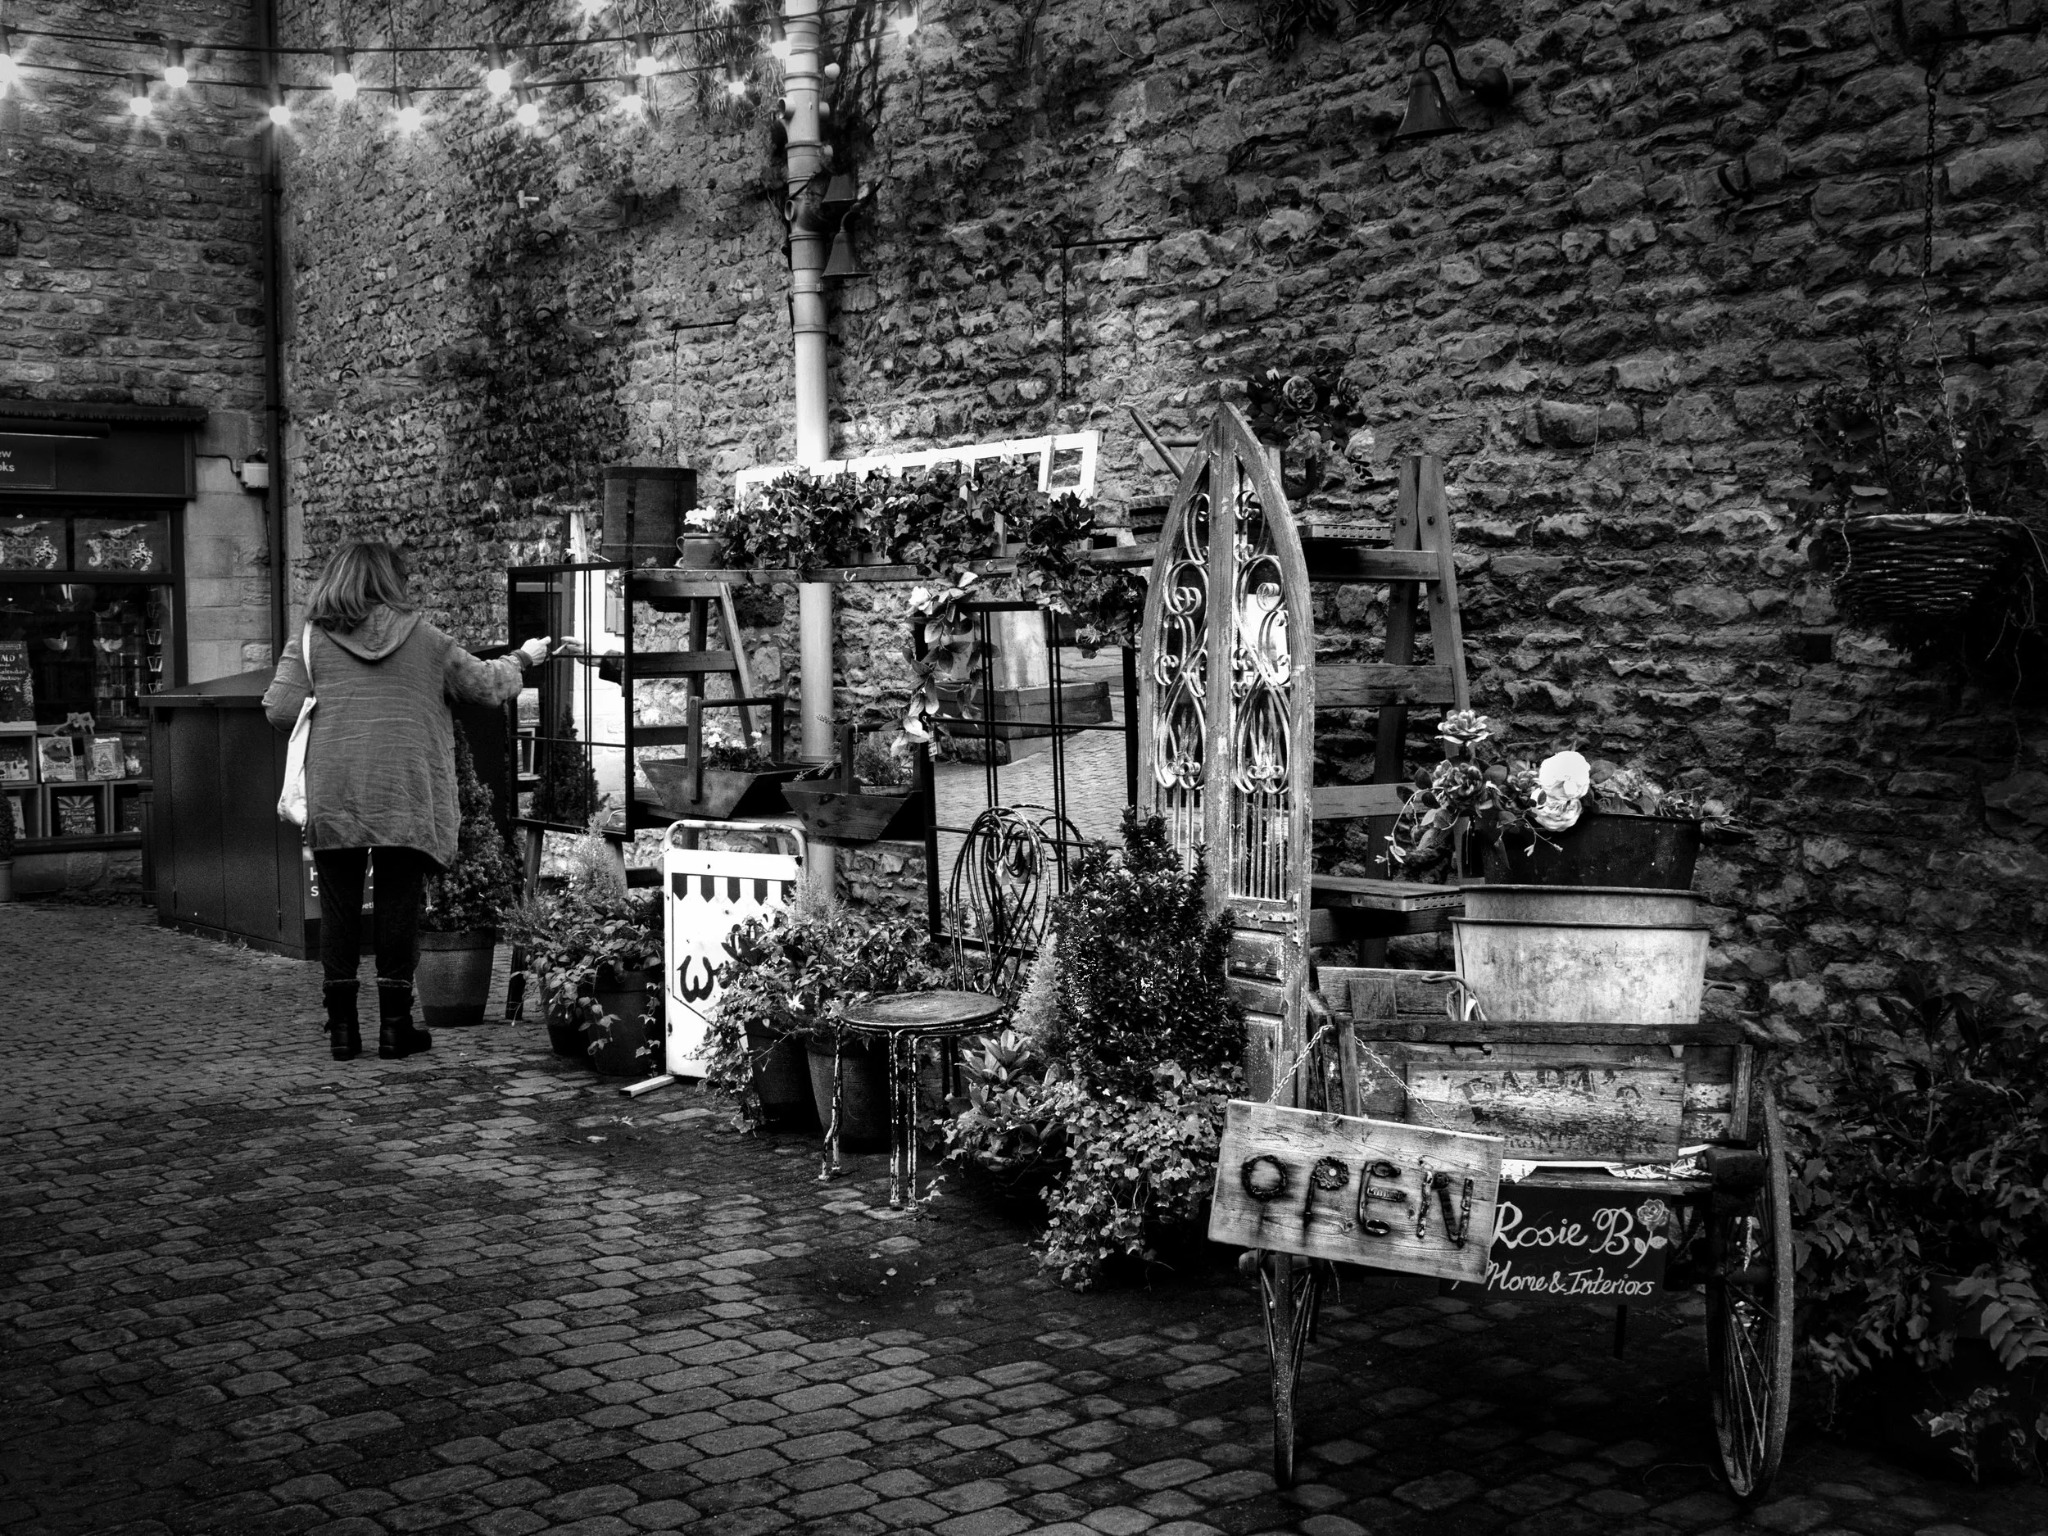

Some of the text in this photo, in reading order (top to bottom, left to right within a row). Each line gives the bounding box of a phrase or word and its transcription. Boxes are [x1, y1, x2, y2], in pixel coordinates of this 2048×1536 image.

[1241, 1154, 1474, 1248] OPEN
[1491, 1202, 1633, 1255] Rosie B
[1563, 1267, 1655, 1295] Interiors
